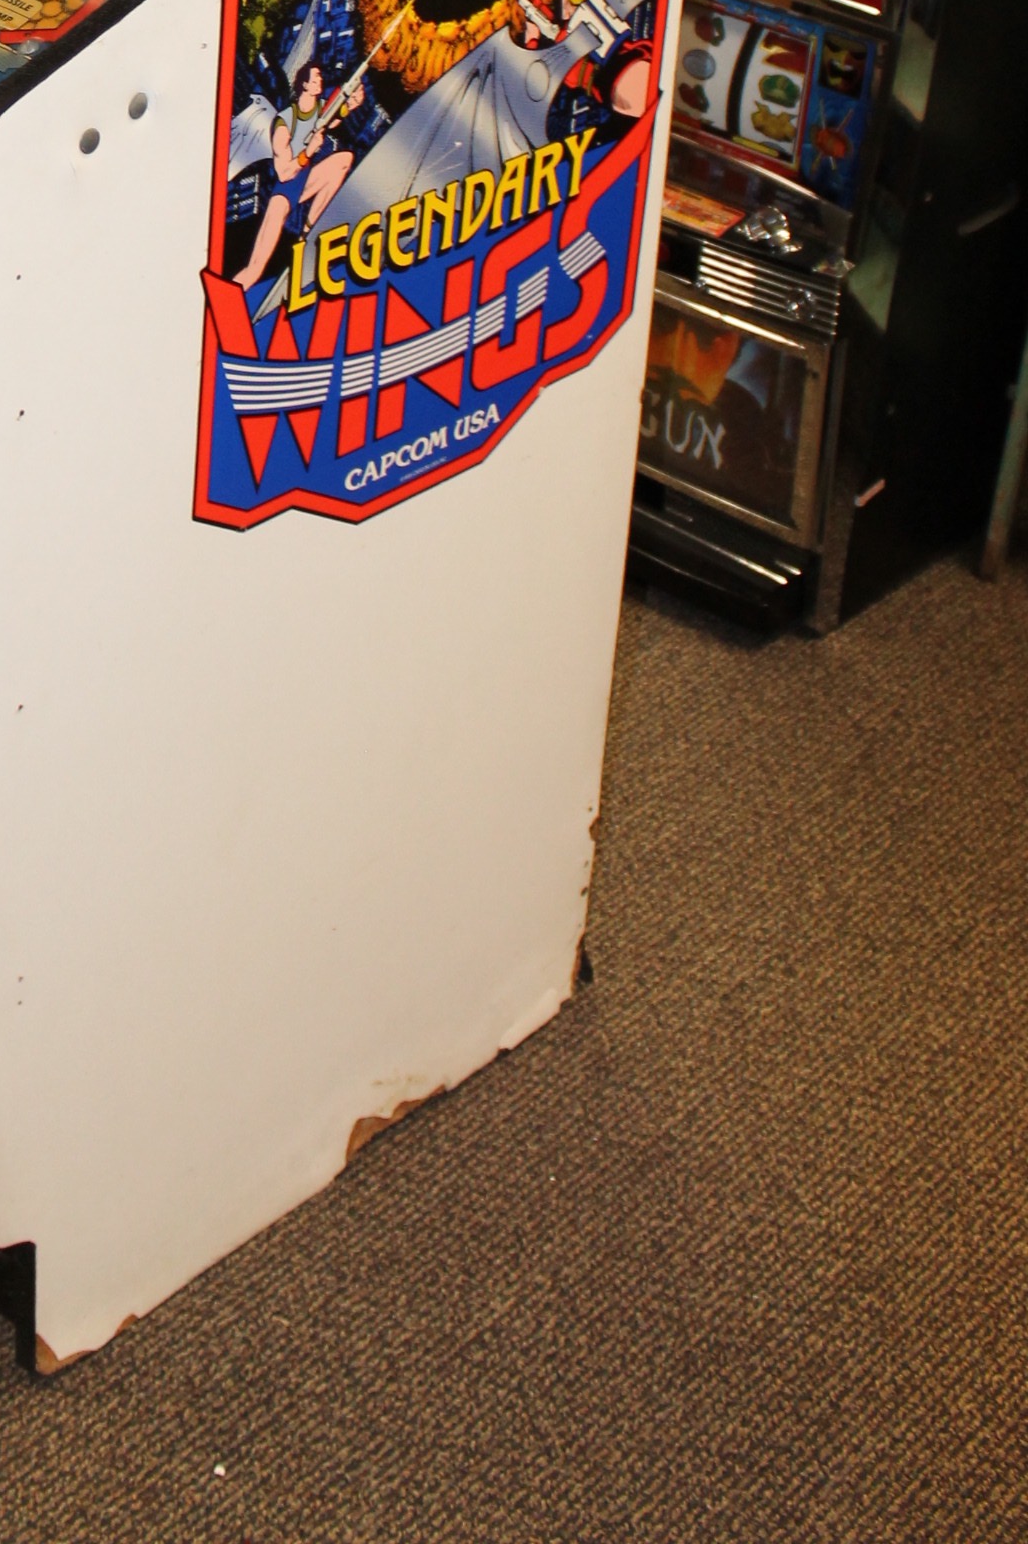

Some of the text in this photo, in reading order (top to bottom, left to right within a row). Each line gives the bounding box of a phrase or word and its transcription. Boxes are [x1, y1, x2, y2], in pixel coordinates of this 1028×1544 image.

[201, 93, 662, 495] WINGS
[286, 126, 598, 314] LEGENDARY
[343, 426, 448, 492] CAPCOM
[453, 403, 501, 441] USA
